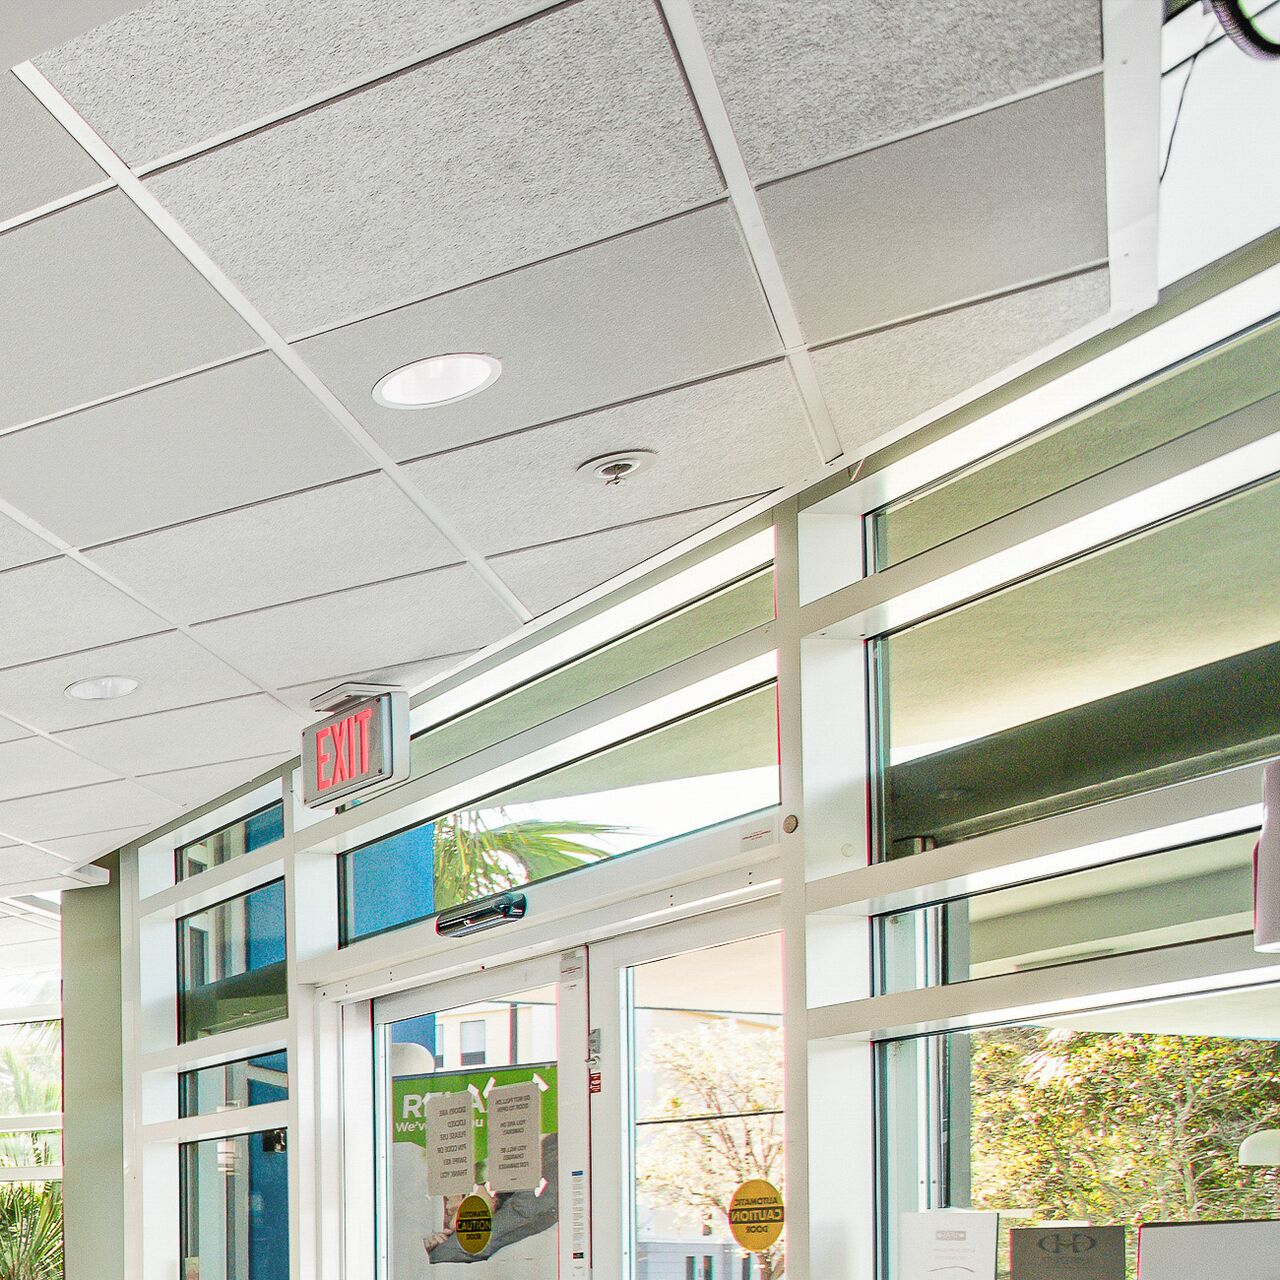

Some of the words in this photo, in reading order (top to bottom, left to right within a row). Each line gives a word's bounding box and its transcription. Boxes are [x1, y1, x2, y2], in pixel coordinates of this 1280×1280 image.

[316, 708, 374, 791] EXIT
[396, 1121, 426, 1133] We'v
[458, 1220, 491, 1230] CAUTION
